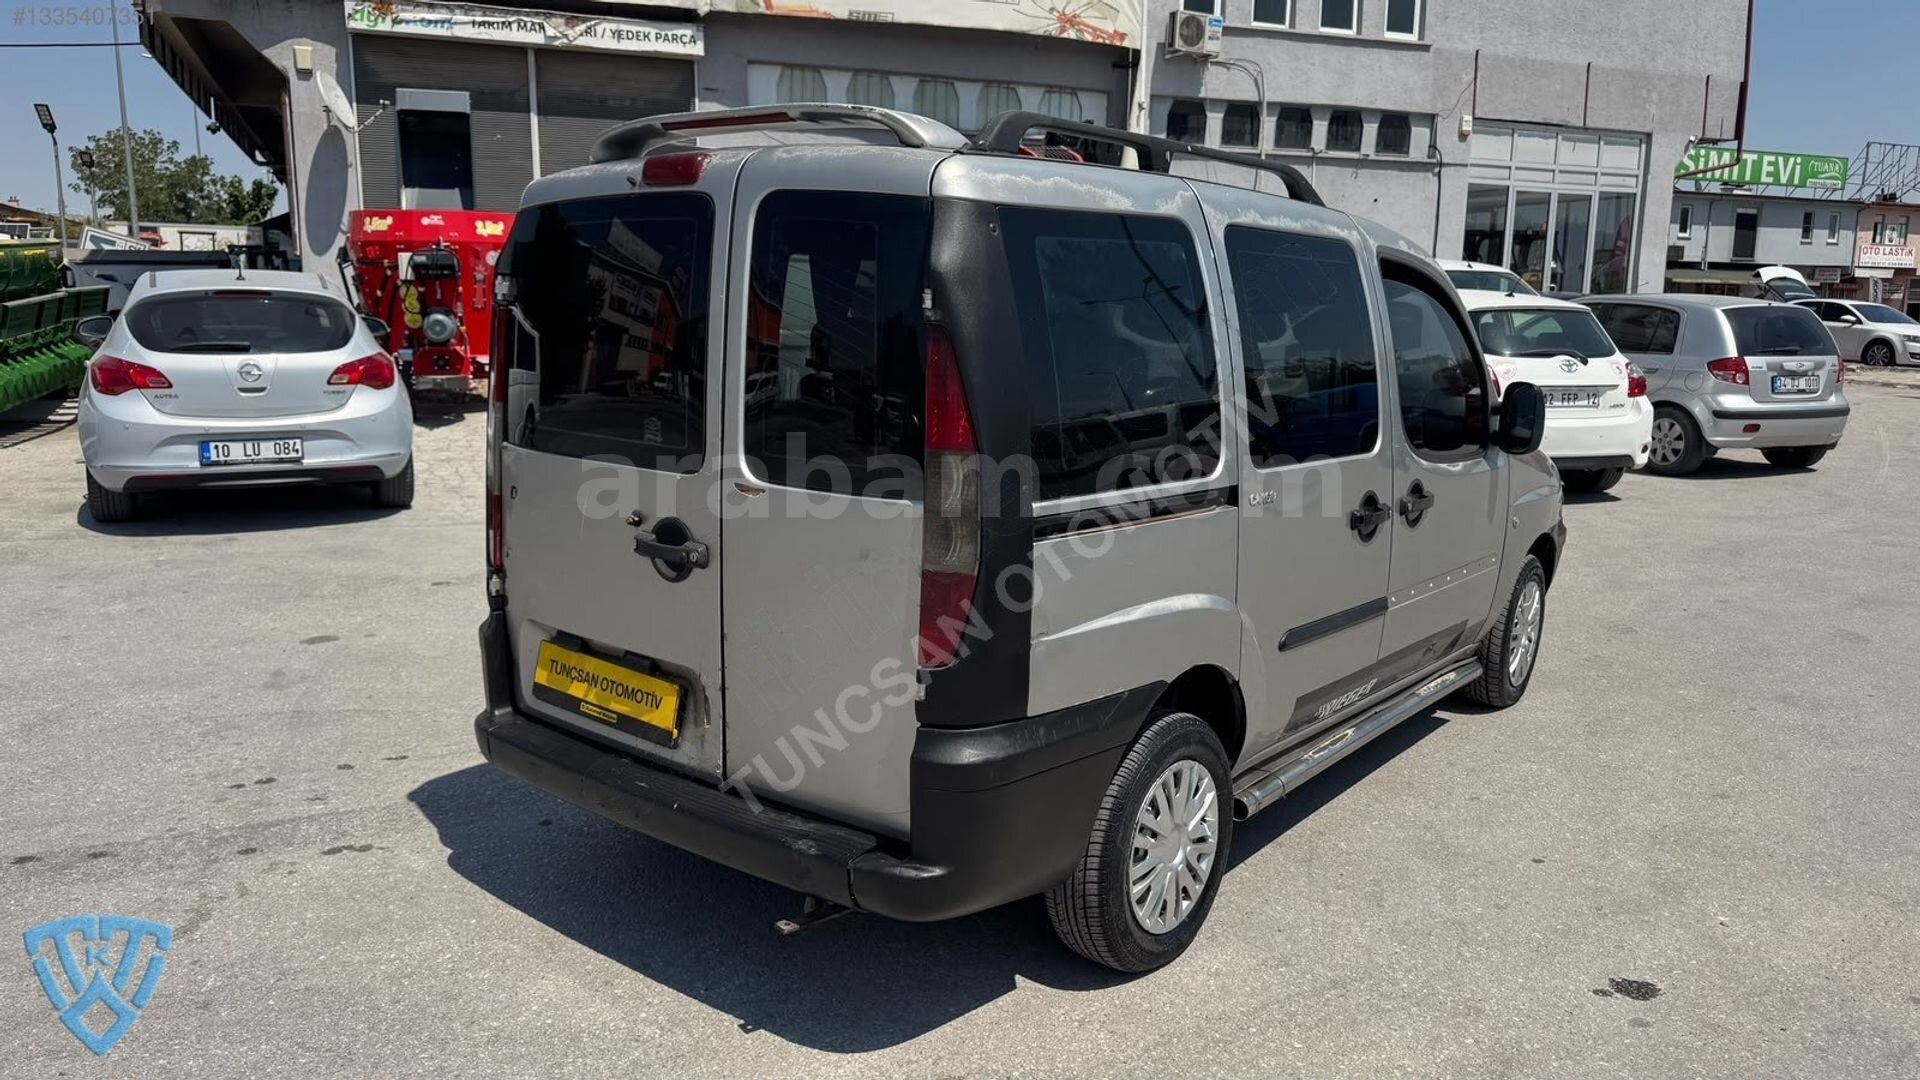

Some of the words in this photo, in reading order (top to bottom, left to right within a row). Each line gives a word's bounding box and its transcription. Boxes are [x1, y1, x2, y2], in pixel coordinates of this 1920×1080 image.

[610, 28, 651, 42] YEDEK
[655, 31, 697, 46] PARÇA
[1862, 246, 1881, 255] OTO
[1561, 393, 1578, 405] FFP
[1586, 393, 1598, 405] 12
[213, 444, 231, 458] 10
[243, 442, 261, 457] LU
[273, 440, 300, 456] 084
[549, 658, 600, 688] TUNÇSAN
